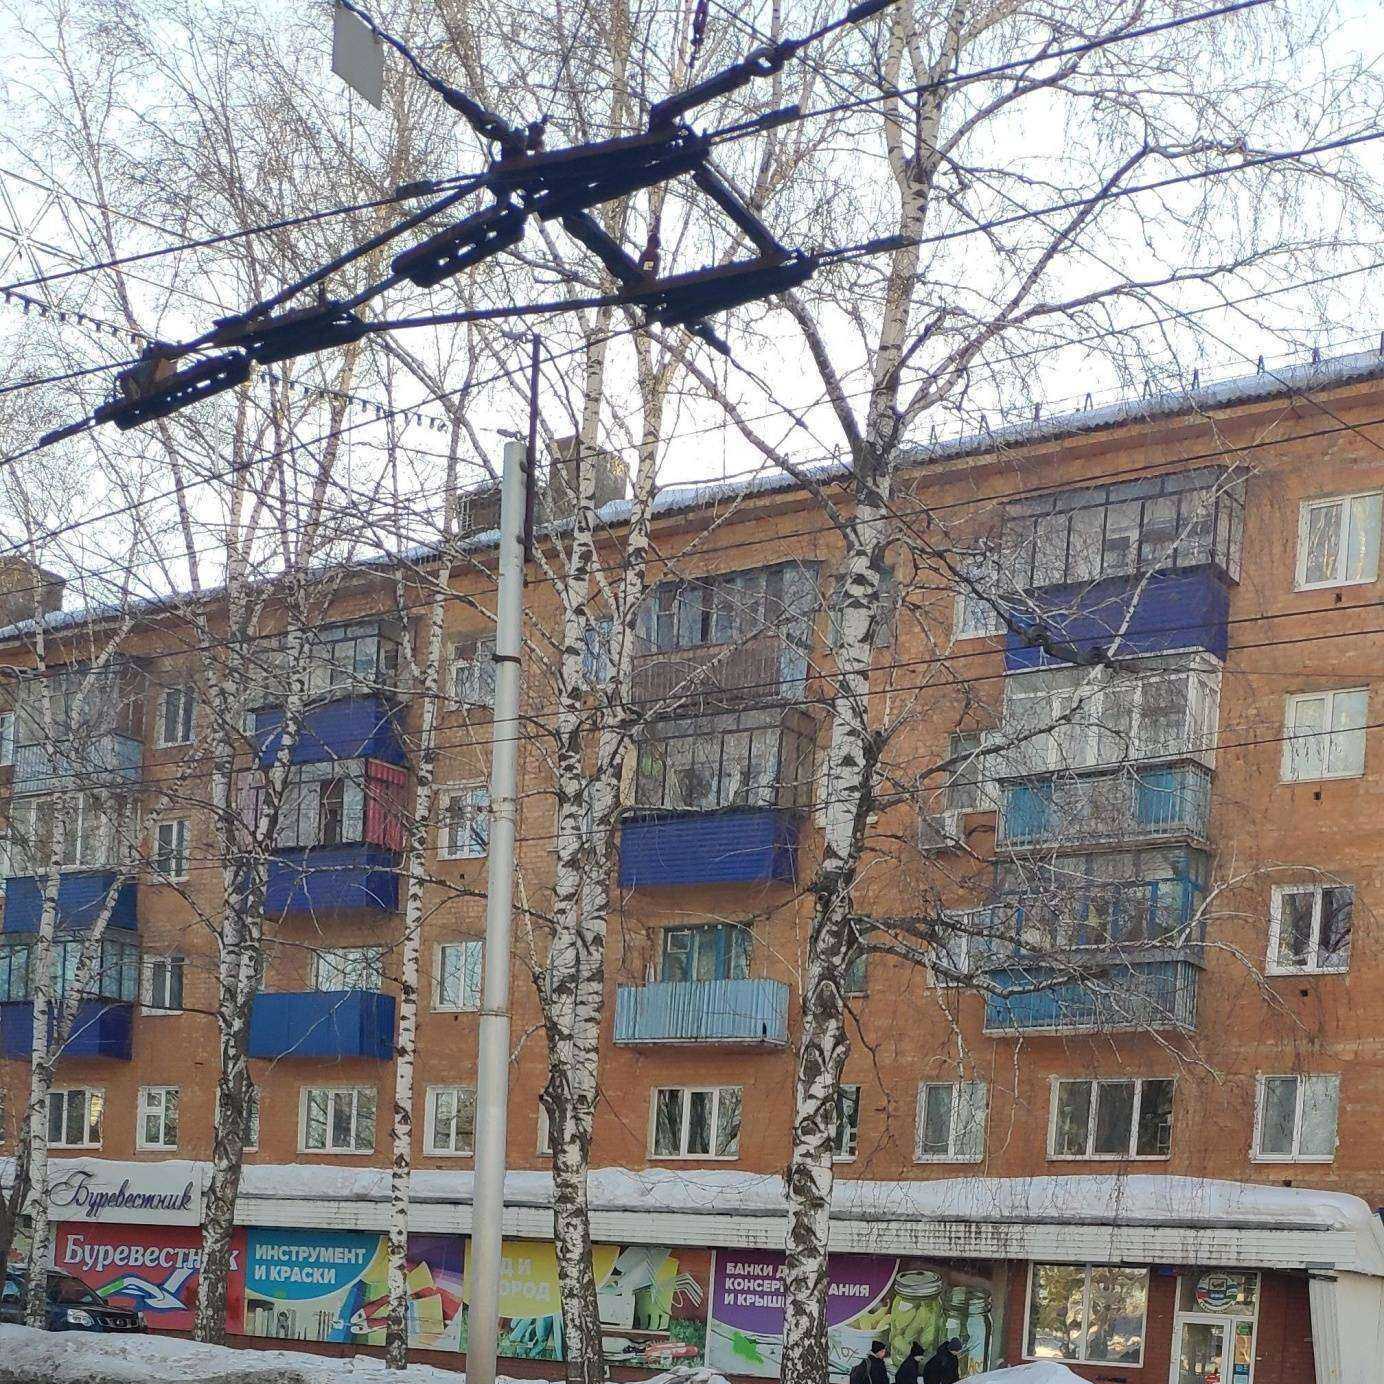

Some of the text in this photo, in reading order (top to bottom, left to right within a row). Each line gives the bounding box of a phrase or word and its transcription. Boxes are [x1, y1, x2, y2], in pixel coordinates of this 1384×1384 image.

[49, 1170, 194, 1218] Буревестник
[63, 1234, 240, 1272] Буревестнк
[255, 1244, 366, 1265] ИНСТРУМЕНТ
[254, 1264, 336, 1284] И КРАСКИ
[726, 1262, 773, 1276] БАНКИ
[724, 1292, 785, 1308] И КРЫШ
